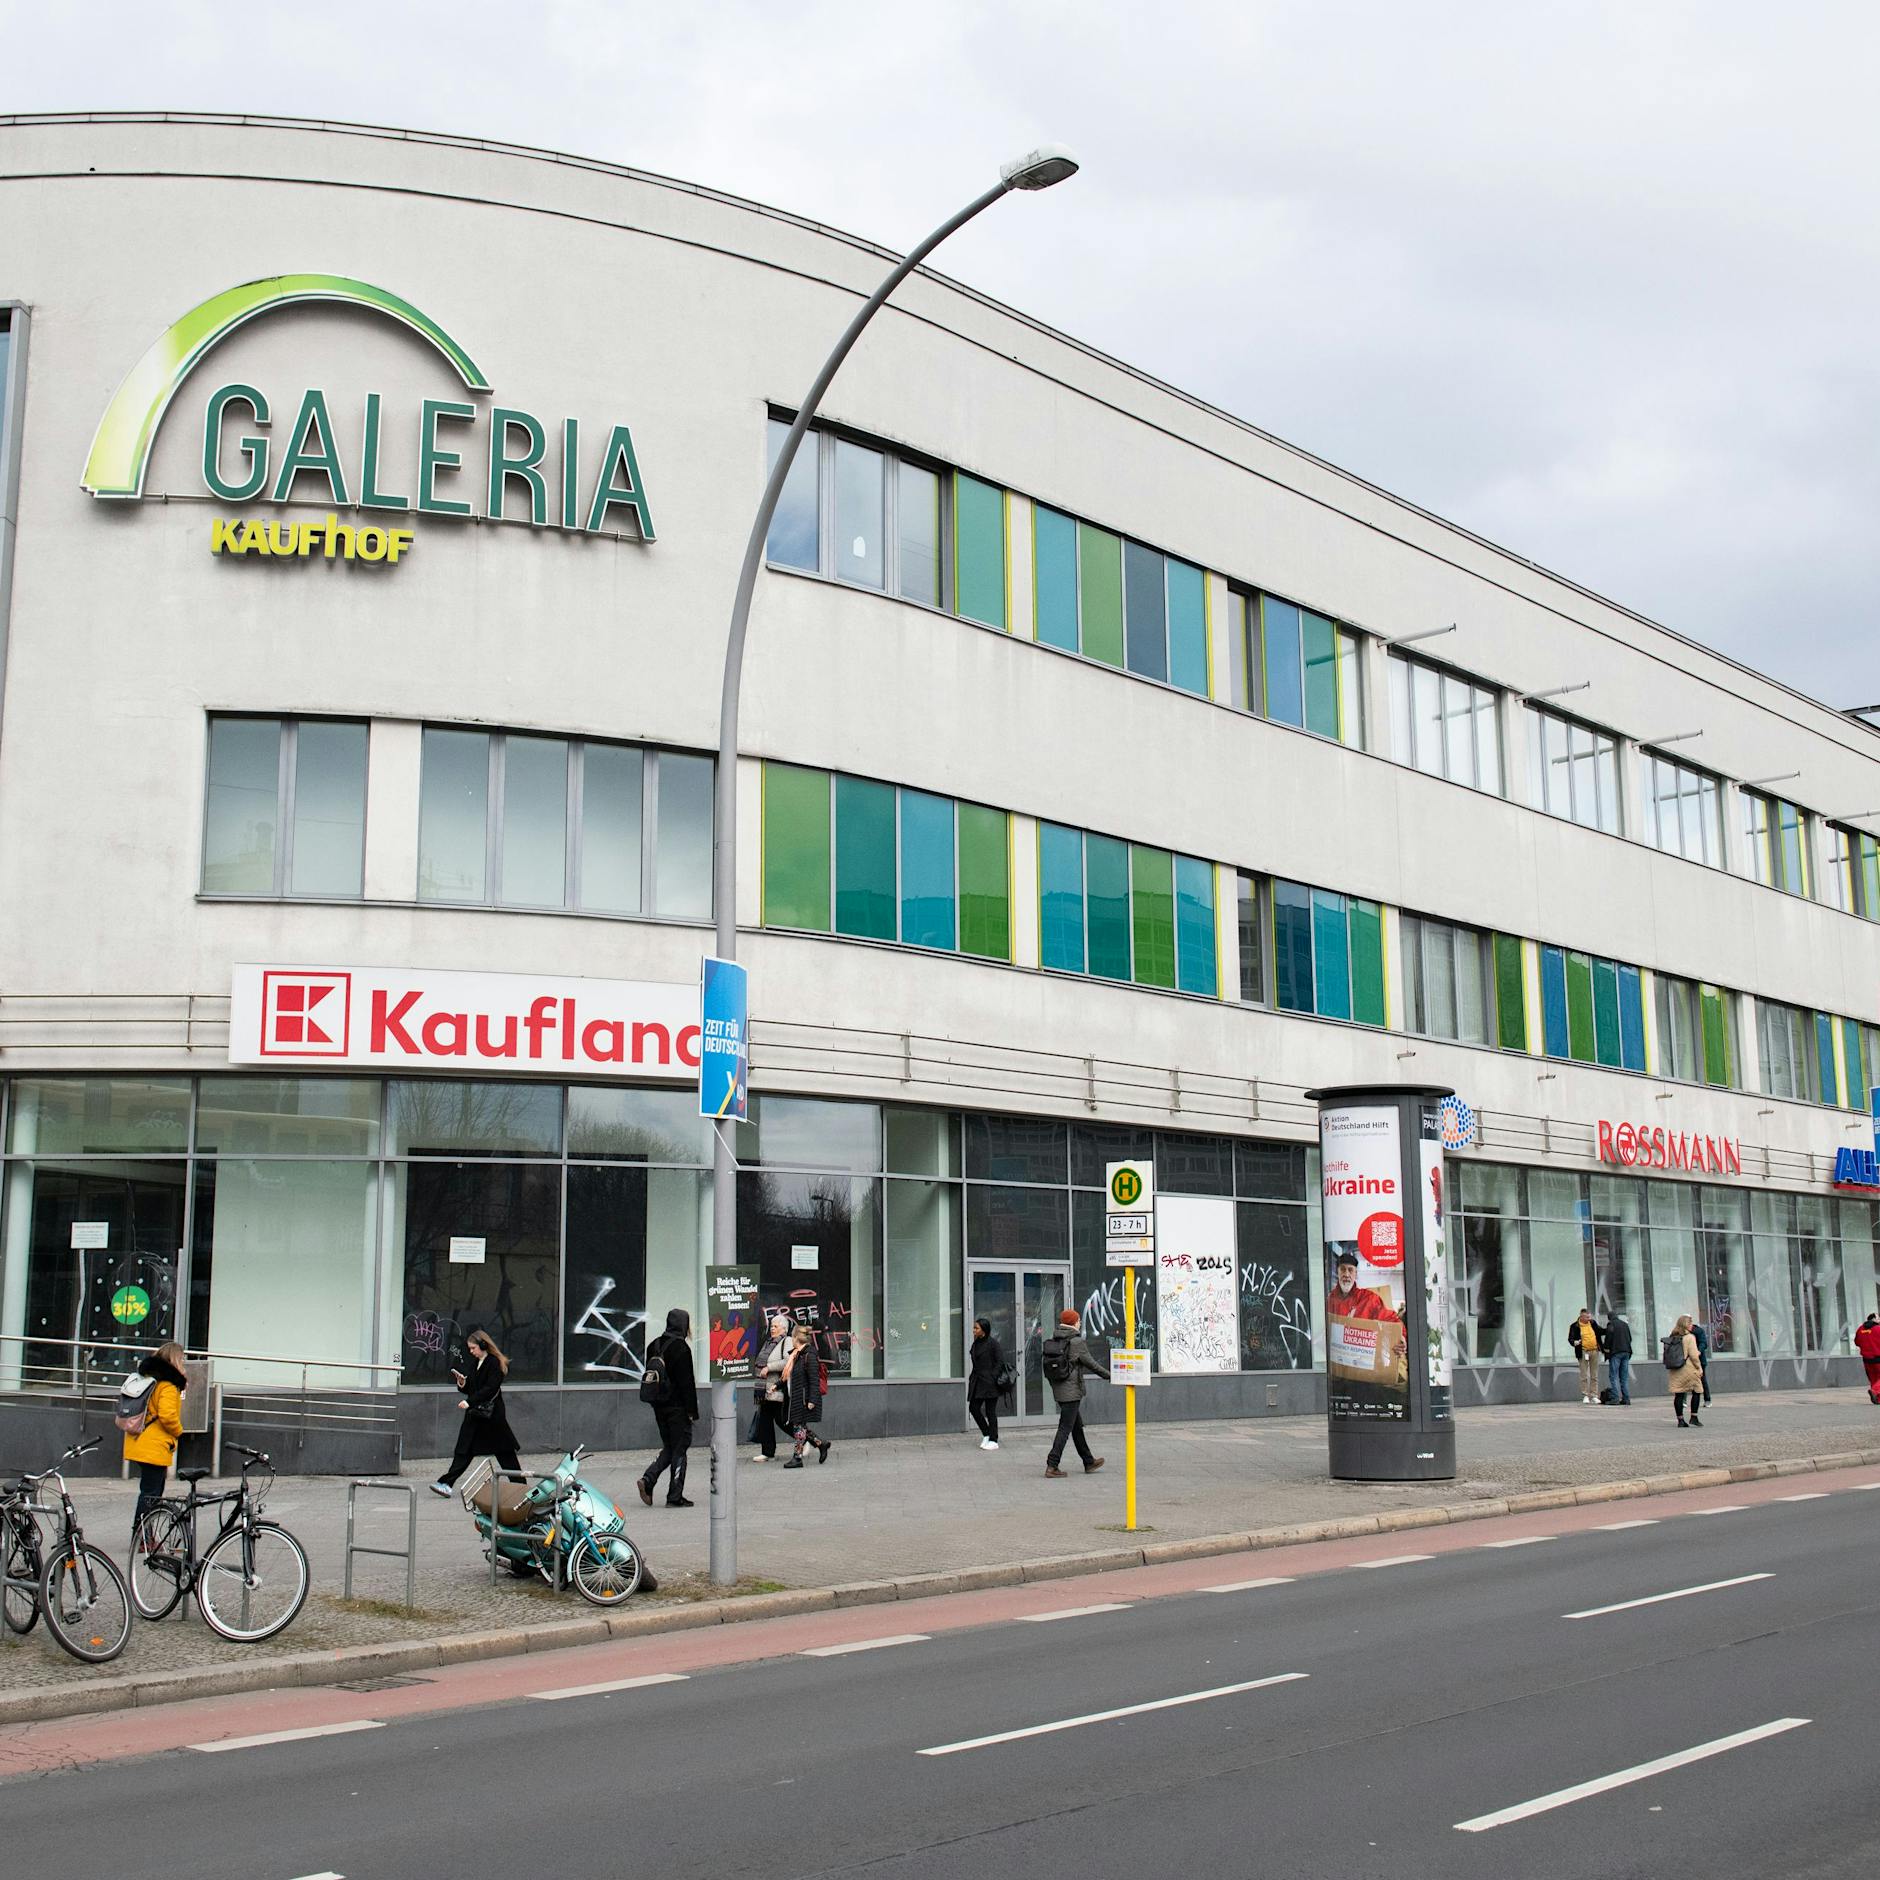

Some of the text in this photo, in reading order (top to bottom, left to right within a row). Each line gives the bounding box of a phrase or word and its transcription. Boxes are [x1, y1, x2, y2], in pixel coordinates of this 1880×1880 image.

[201, 383, 657, 544] GALERIA
[704, 1019, 724, 1036] ZEIT
[704, 1036, 747, 1059] DEUTSC
[1331, 1121, 1389, 1131] Deutschland Hilft
[1597, 1119, 1741, 1176] ROSSMANN
[1323, 1160, 1349, 1173] othilfe
[1118, 1176, 1133, 1197] H
[1324, 1175, 1395, 1197] Ukraine
[1112, 1220, 1121, 1230] 23
[1129, 1220, 1134, 1230] 7
[1136, 1219, 1142, 1229] h
[716, 1276, 751, 1286] Reiche für
[708, 1284, 758, 1297] grünen Wandel
[720, 1293, 743, 1302] zahlen
[113, 1301, 148, 1317] 30%
[728, 1300, 750, 1310] lassen!
[762, 1304, 820, 1334] FREE
[1344, 1327, 1377, 1340] NOTHILFE
[1344, 1335, 1376, 1347] UKRAINE
[727, 1365, 749, 1373] MERA25
